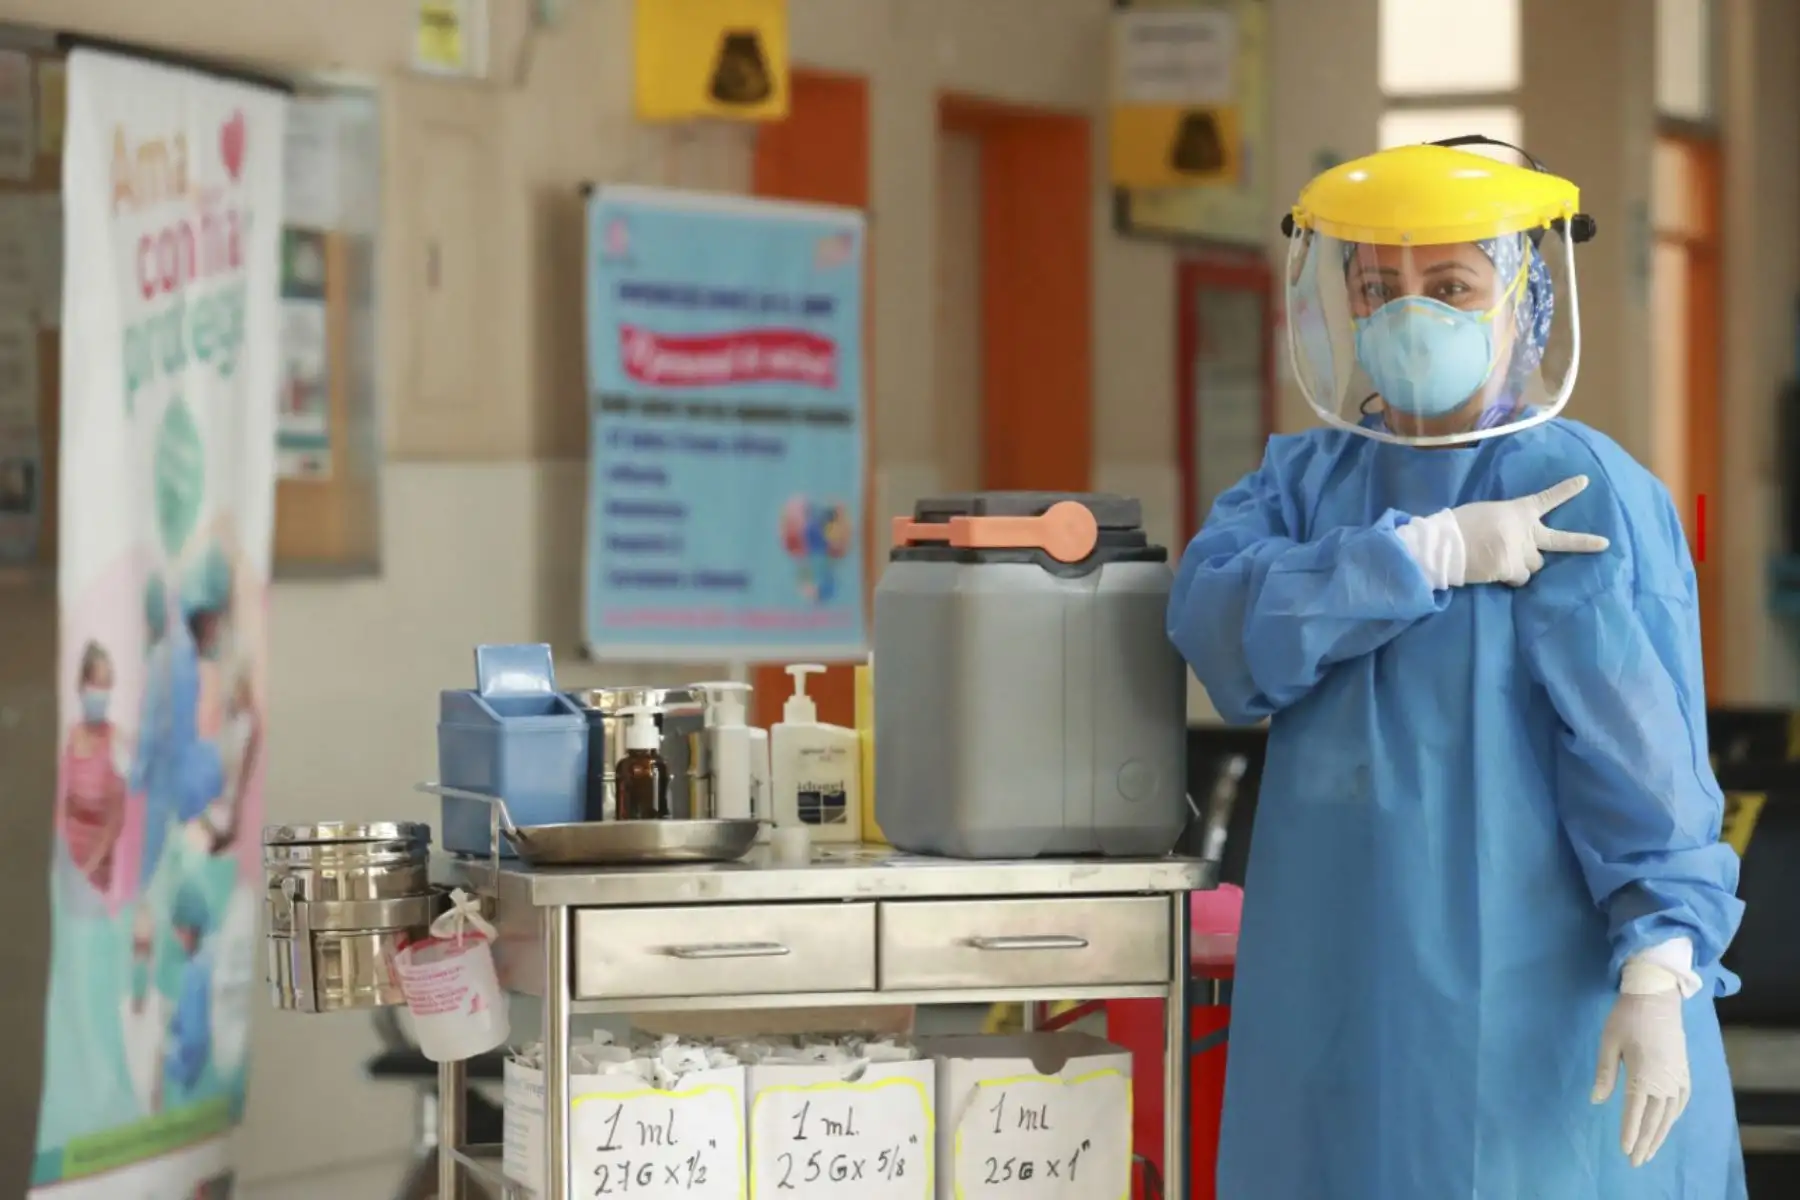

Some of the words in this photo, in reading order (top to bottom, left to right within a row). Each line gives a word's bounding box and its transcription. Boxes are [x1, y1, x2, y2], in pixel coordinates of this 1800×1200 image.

[596, 1103, 623, 1152] 1
[791, 1100, 811, 1141] 1
[989, 1091, 1007, 1134] 1
